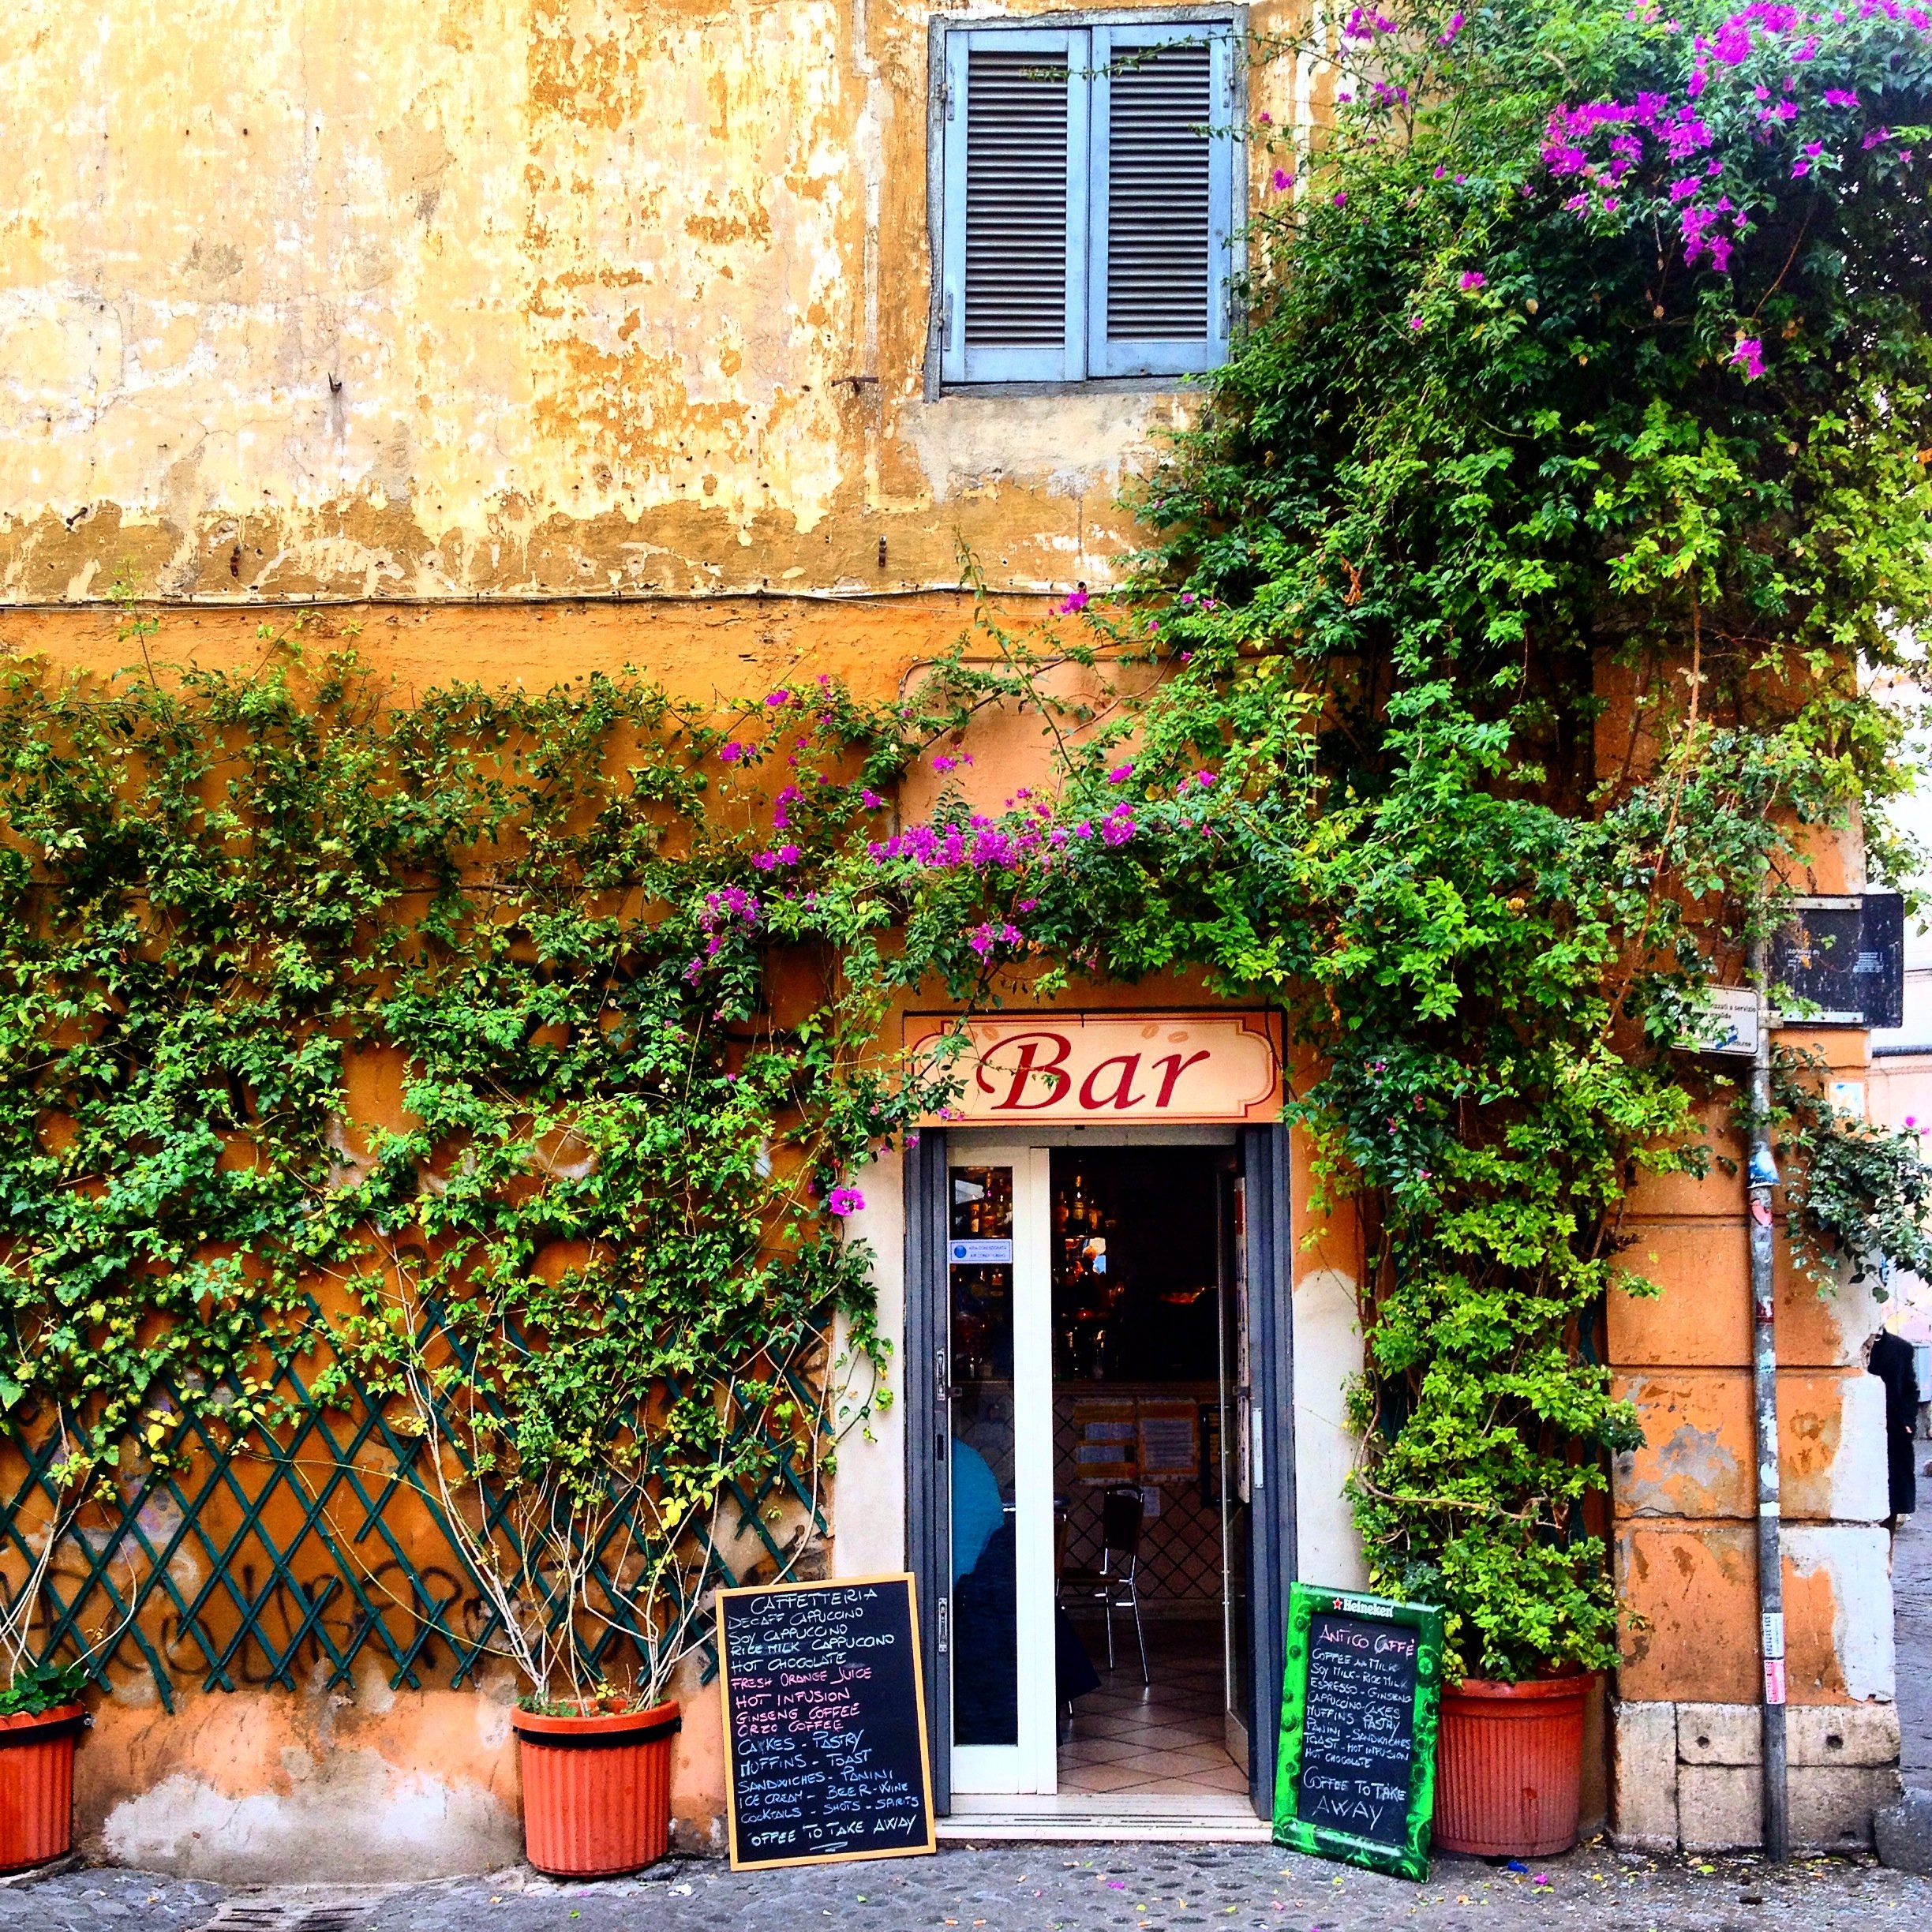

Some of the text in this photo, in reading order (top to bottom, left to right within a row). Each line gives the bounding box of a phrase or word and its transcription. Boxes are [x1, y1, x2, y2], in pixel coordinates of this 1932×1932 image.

[976, 1032, 1211, 1110] Bar
[751, 1588, 878, 1615] CAFFETTERIA
[1343, 1599, 1395, 1619] Heineken
[728, 1612, 785, 1630] DECAFF
[728, 1631, 756, 1651] SOY
[1316, 1623, 1369, 1649] ANTICO
[768, 1642, 800, 1654] MILK
[1312, 1647, 1352, 1664] COFFEE
[731, 1652, 847, 1675] HOT CHOCOLATE
[731, 1667, 872, 1690] FRESH ORANGE JUICE
[736, 1687, 850, 1709] HOT INFUSION
[736, 1702, 860, 1724] GINSENG COFFEE
[1306, 1705, 1401, 1739] MUFFINS PASTRY
[737, 1719, 844, 1738] ORZO COFFEE
[1306, 1717, 1341, 1737] PANINI
[812, 1729, 865, 1754] PASTRY
[1303, 1732, 1340, 1750] TOAST
[1346, 1743, 1365, 1753] HOT
[740, 1754, 807, 1777] MUFFINS
[826, 1748, 872, 1767] TOAST
[840, 1765, 893, 1781] PANINI
[1303, 1765, 1407, 1803] COFFEE TO TAKE
[739, 1794, 760, 1810] ICE
[765, 1790, 803, 1805] CREAM
[740, 1807, 802, 1824] COCKTAILS
[822, 1800, 861, 1815] SHOTS
[875, 1796, 919, 1810] SPIRITS
[1312, 1795, 1384, 1831] AWAY
[747, 1814, 917, 1847] OFFEE TO TAKE AWAY
